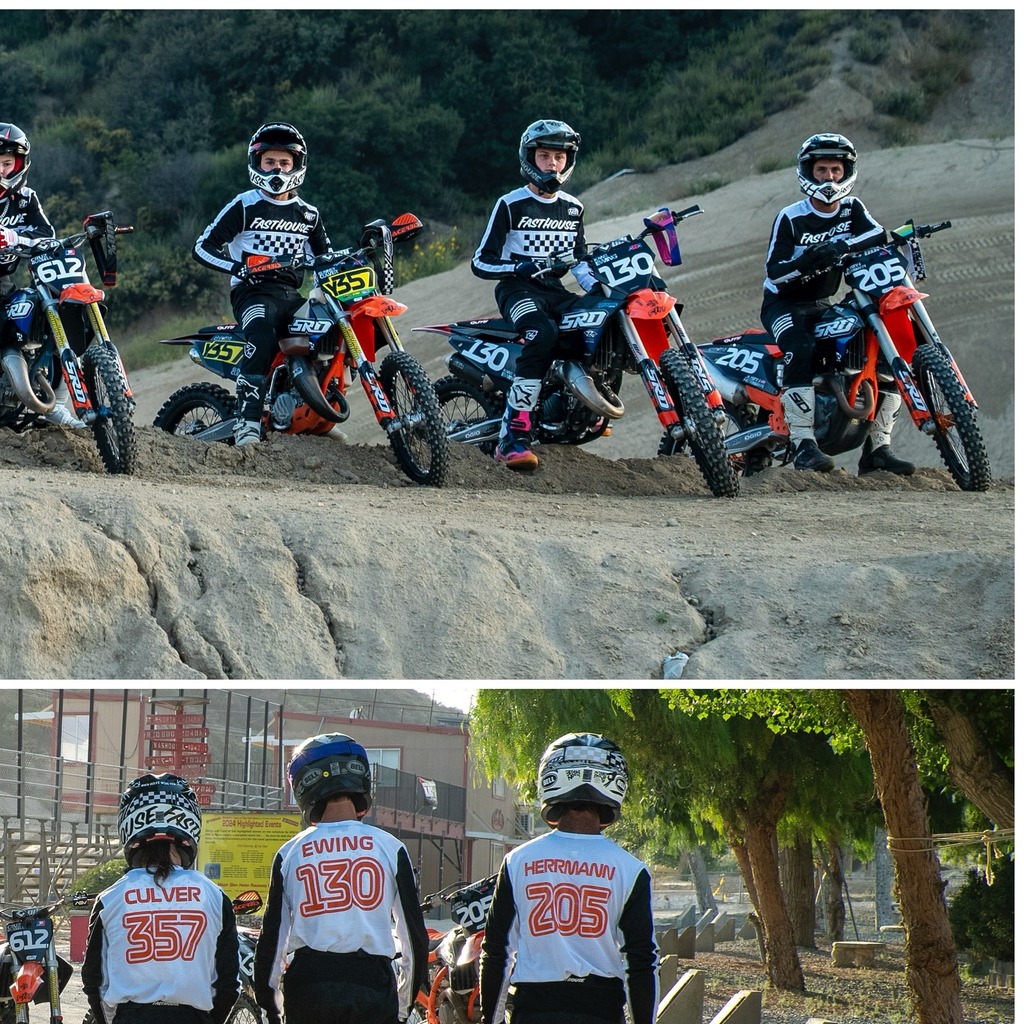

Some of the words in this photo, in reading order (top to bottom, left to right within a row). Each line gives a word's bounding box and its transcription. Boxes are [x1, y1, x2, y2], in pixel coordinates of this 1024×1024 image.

[250, 217, 313, 234] FASTHOUSE
[518, 216, 579, 231] FASTHOUSE
[37, 257, 84, 283] 612
[598, 253, 653, 287] 130
[854, 258, 906, 292] 205
[323, 270, 375, 298] Y357
[289, 319, 333, 333] SRD
[561, 311, 607, 328] SRD
[815, 317, 858, 337] SRD
[203, 342, 244, 364] Y357
[462, 340, 509, 371] 130
[716, 348, 764, 374] 205
[65, 360, 86, 403] SRD
[647, 369, 670, 409] SRD
[305, 771, 319, 783] BELL
[222, 820, 236, 828] 2024
[237, 820, 264, 829] Highlighted
[302, 836, 374, 857] EWING
[524, 858, 616, 881] HERRMANN
[124, 886, 201, 905] CULVER
[296, 856, 385, 918] 130
[525, 881, 611, 939] 205
[9, 928, 49, 951] 612
[123, 910, 207, 964] 357
